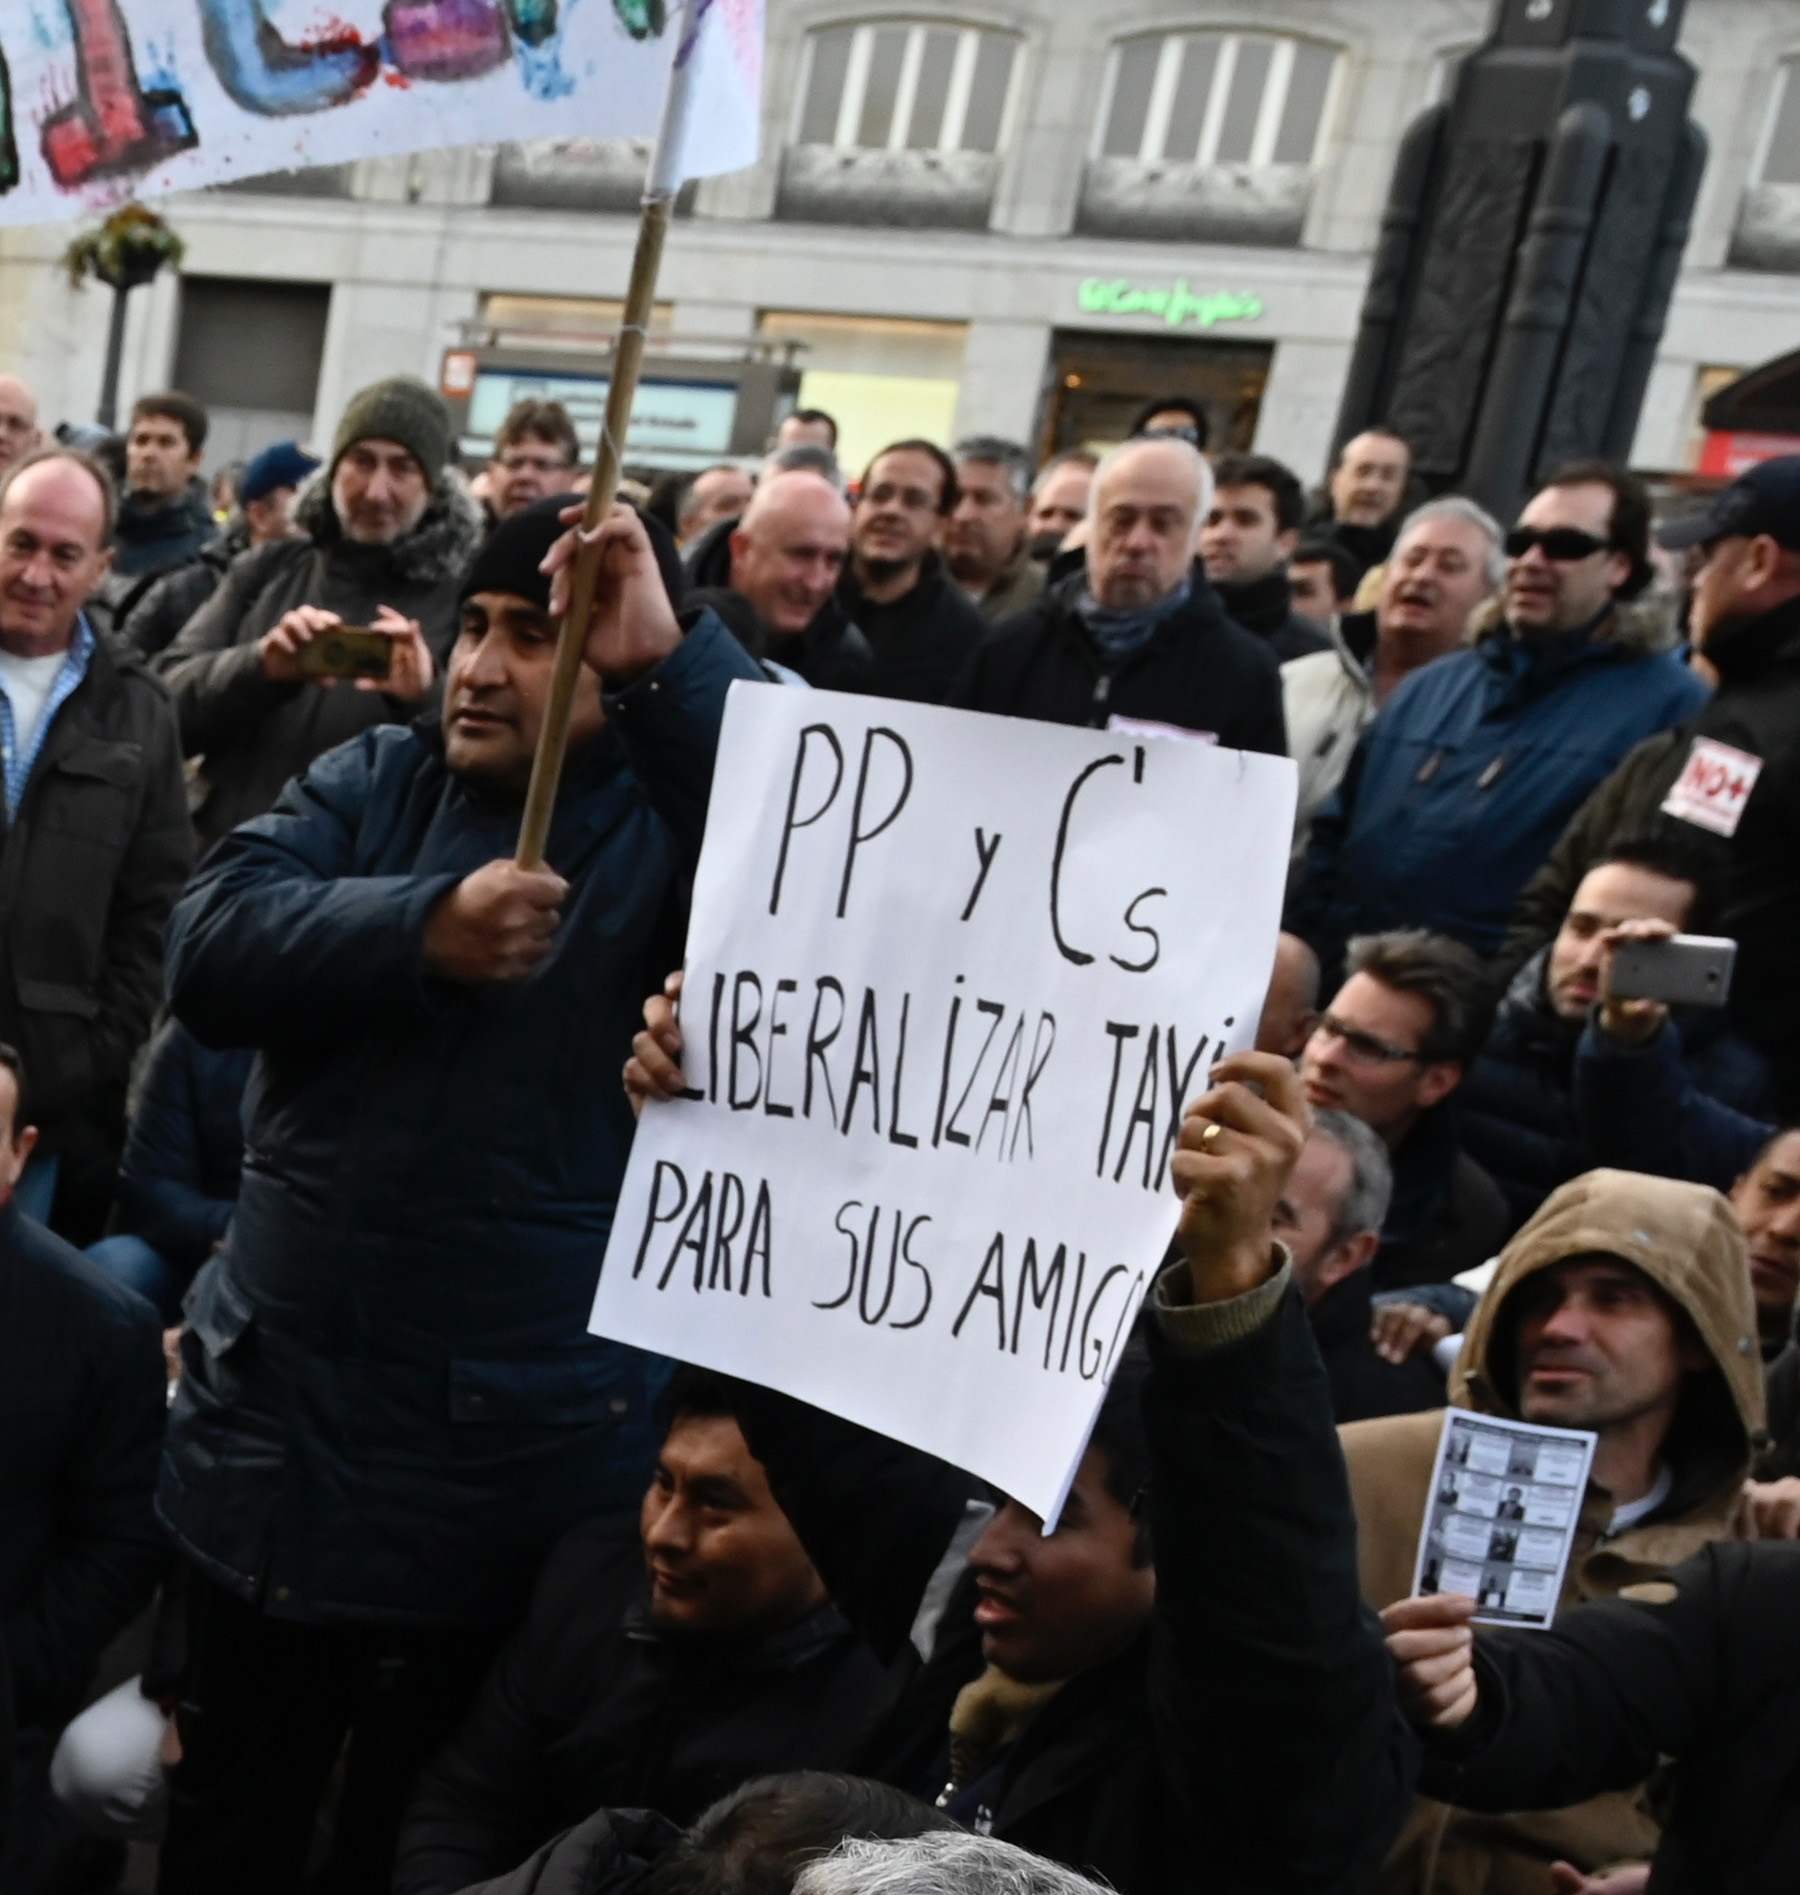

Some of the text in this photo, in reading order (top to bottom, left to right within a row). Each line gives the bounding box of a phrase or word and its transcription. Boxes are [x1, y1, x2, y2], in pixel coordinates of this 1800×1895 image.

[768, 722, 914, 919] PP
[631, 1160, 773, 1299] PARA
[811, 1199, 933, 1330] SUS
